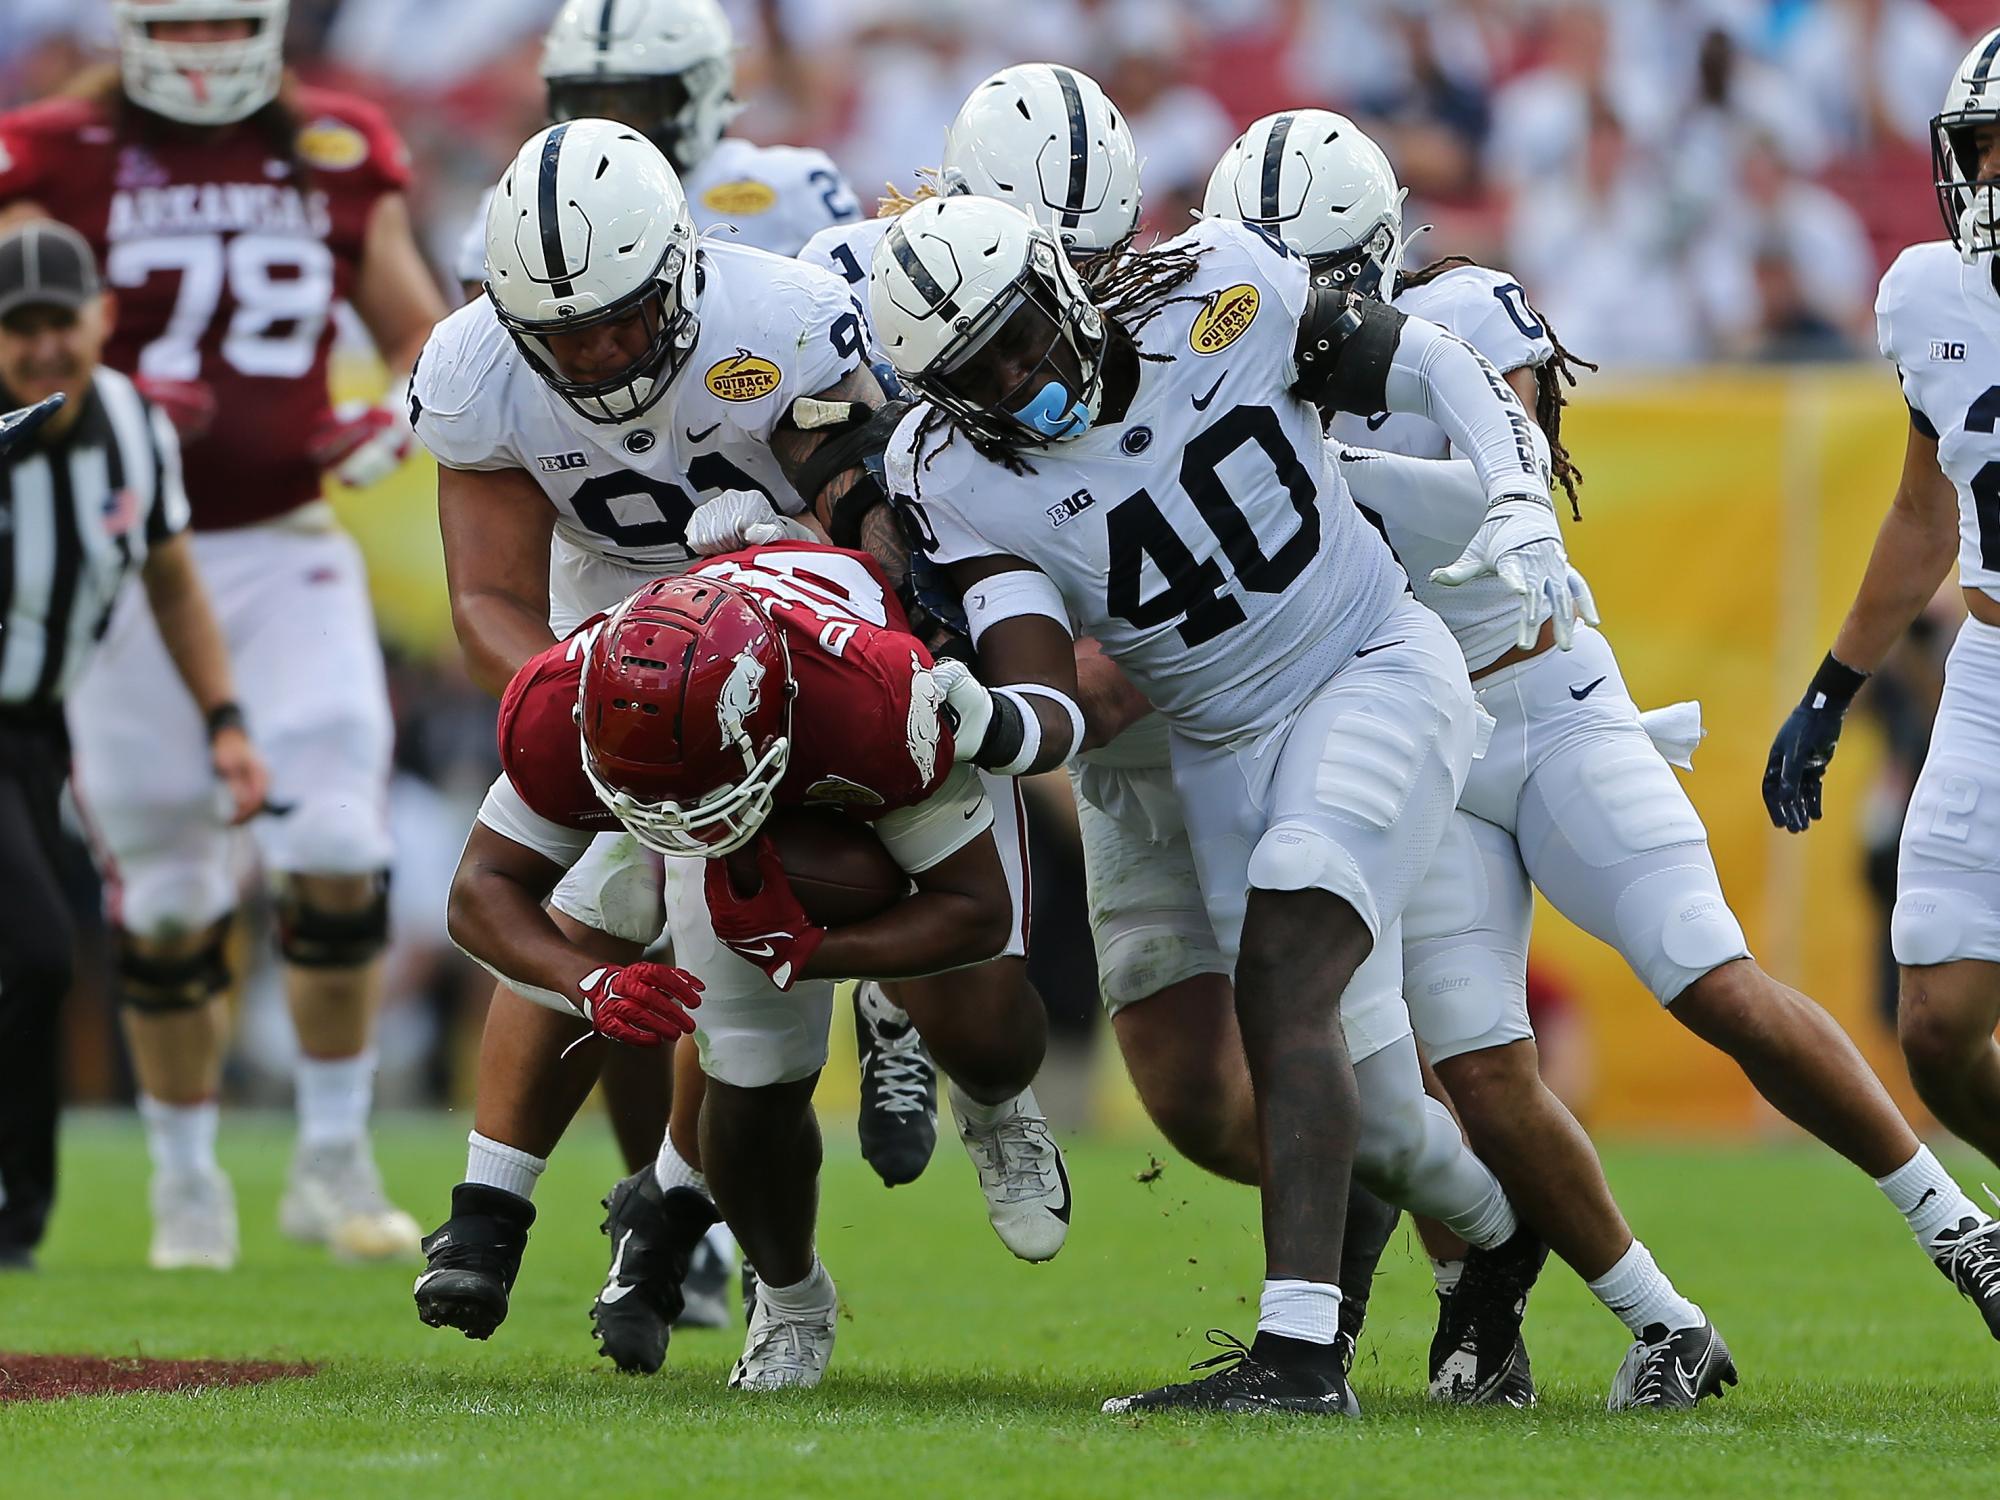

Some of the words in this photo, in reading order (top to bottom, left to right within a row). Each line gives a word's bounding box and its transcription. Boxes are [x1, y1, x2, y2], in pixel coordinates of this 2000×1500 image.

[106, 235, 335, 380] 78
[1201, 295, 1256, 348] OUTBACK
[713, 375, 774, 391] OUTBACK
[1106, 404, 1321, 648] 40
